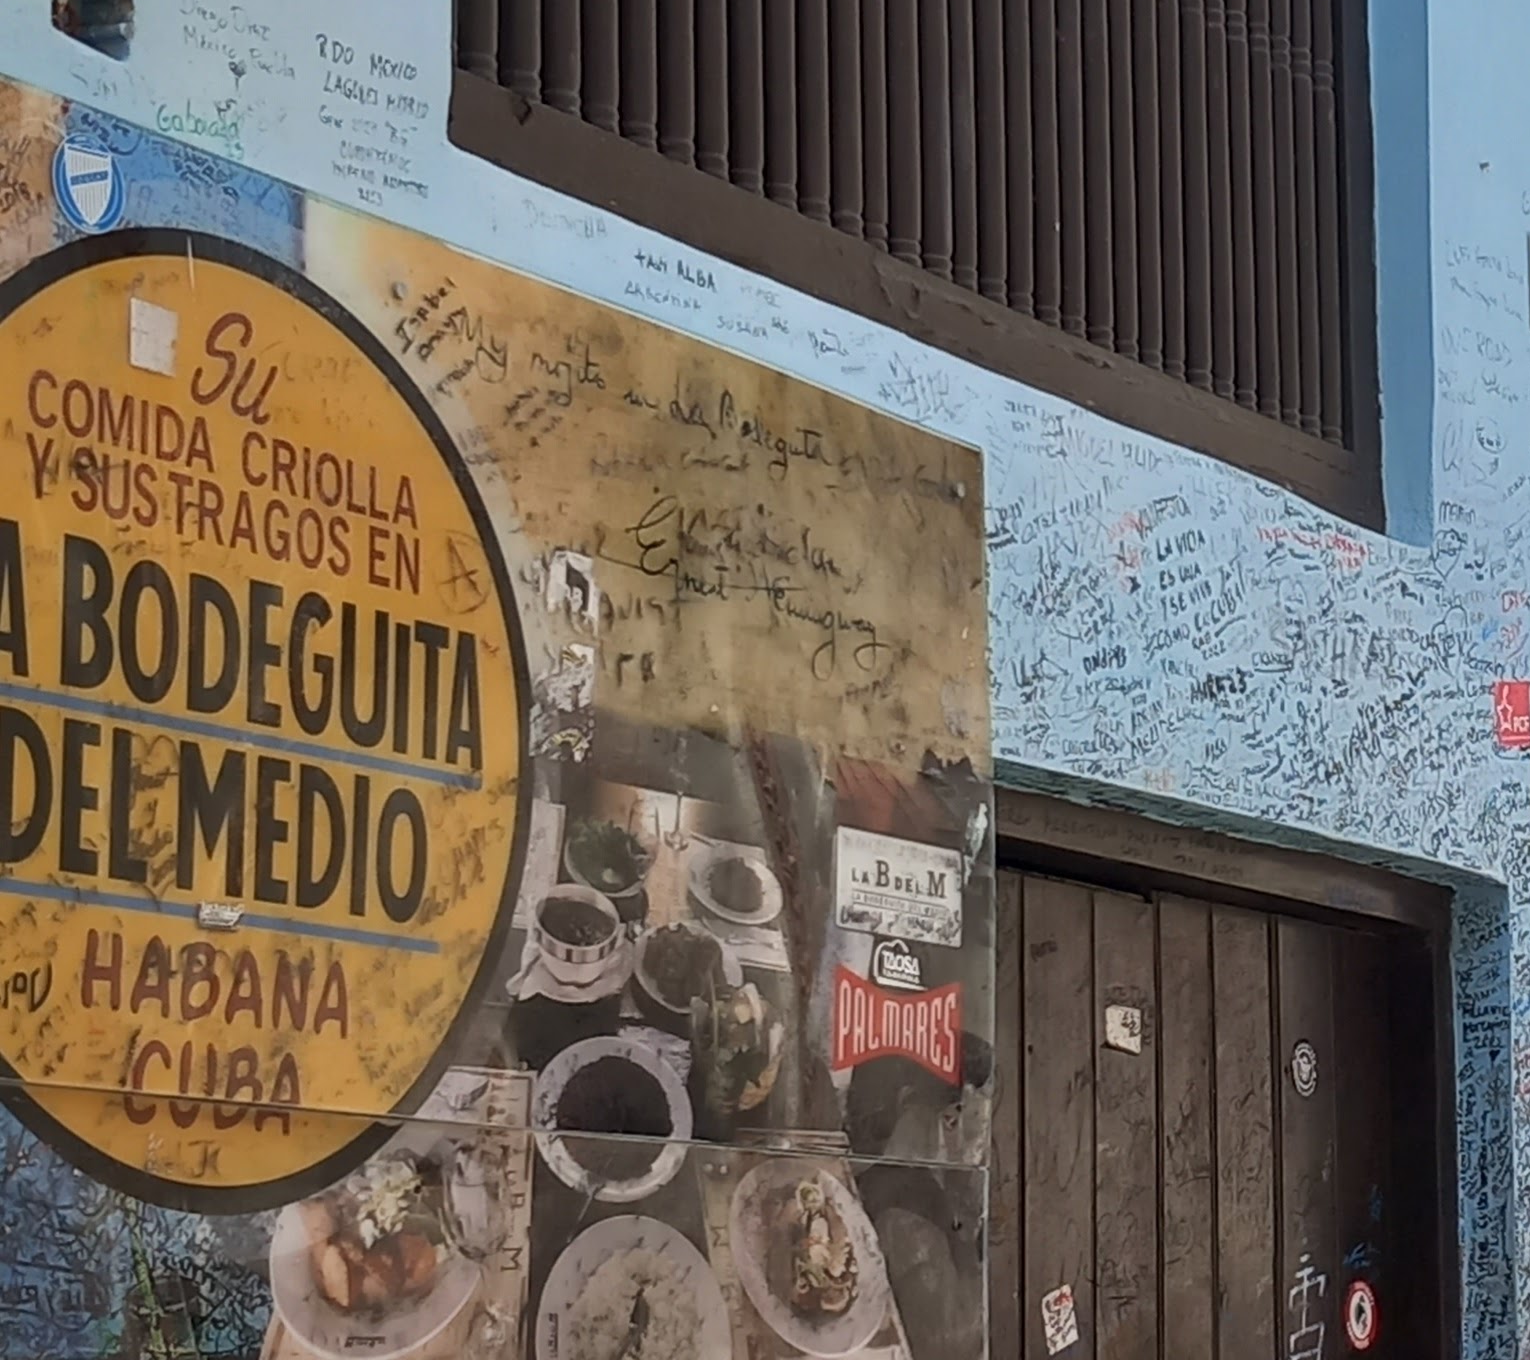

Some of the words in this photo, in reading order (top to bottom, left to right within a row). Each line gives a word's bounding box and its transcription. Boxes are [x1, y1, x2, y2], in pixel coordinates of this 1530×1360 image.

[191, 313, 277, 425] Su
[28, 370, 214, 472] COMIDA
[241, 431, 418, 530] CRIOLLA
[26, 433, 54, 499] Y
[71, 447, 158, 527] SUS
[168, 472, 350, 576] TRAGOS
[368, 528, 420, 595] EN
[60, 533, 482, 771] BODEGUITA
[0, 705, 148, 883] DEL
[176, 740, 427, 923] MEDIO
[852, 867, 869, 884] LA
[875, 859, 890, 888] B
[894, 877, 921, 895] DEL
[927, 870, 946, 899] M
[80, 928, 349, 1039] HABANA
[838, 979, 958, 1074] PALMARES
[123, 1039, 301, 1136] CUBA
